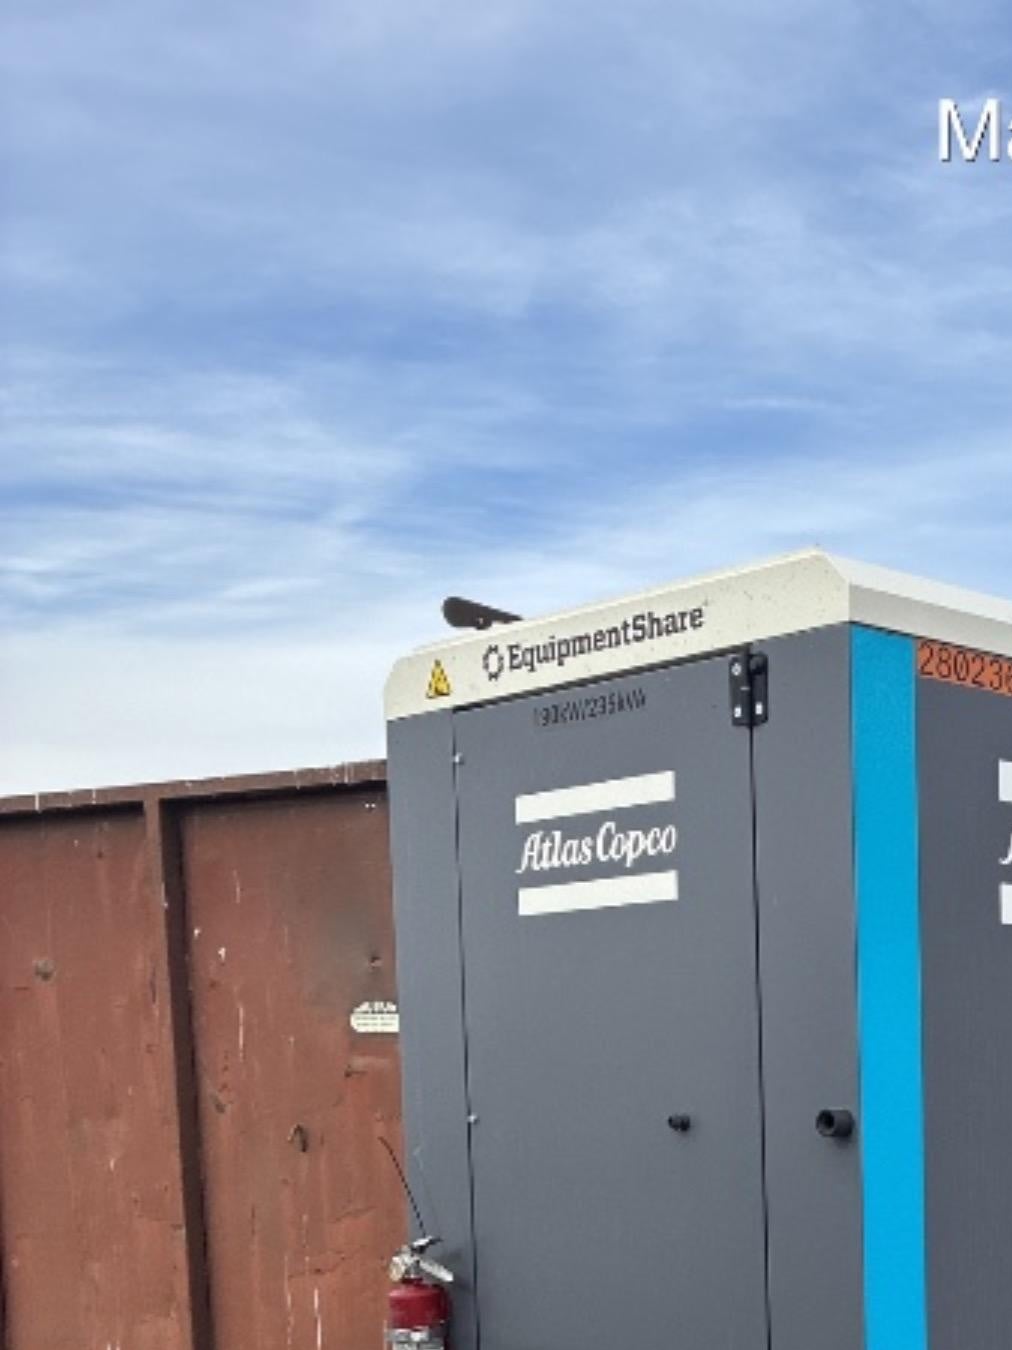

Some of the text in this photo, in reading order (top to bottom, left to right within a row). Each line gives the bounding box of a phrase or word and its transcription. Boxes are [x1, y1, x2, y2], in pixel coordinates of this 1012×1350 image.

[508, 606, 704, 673] EquipmentShare
[514, 821, 678, 874] Atlas Copco
